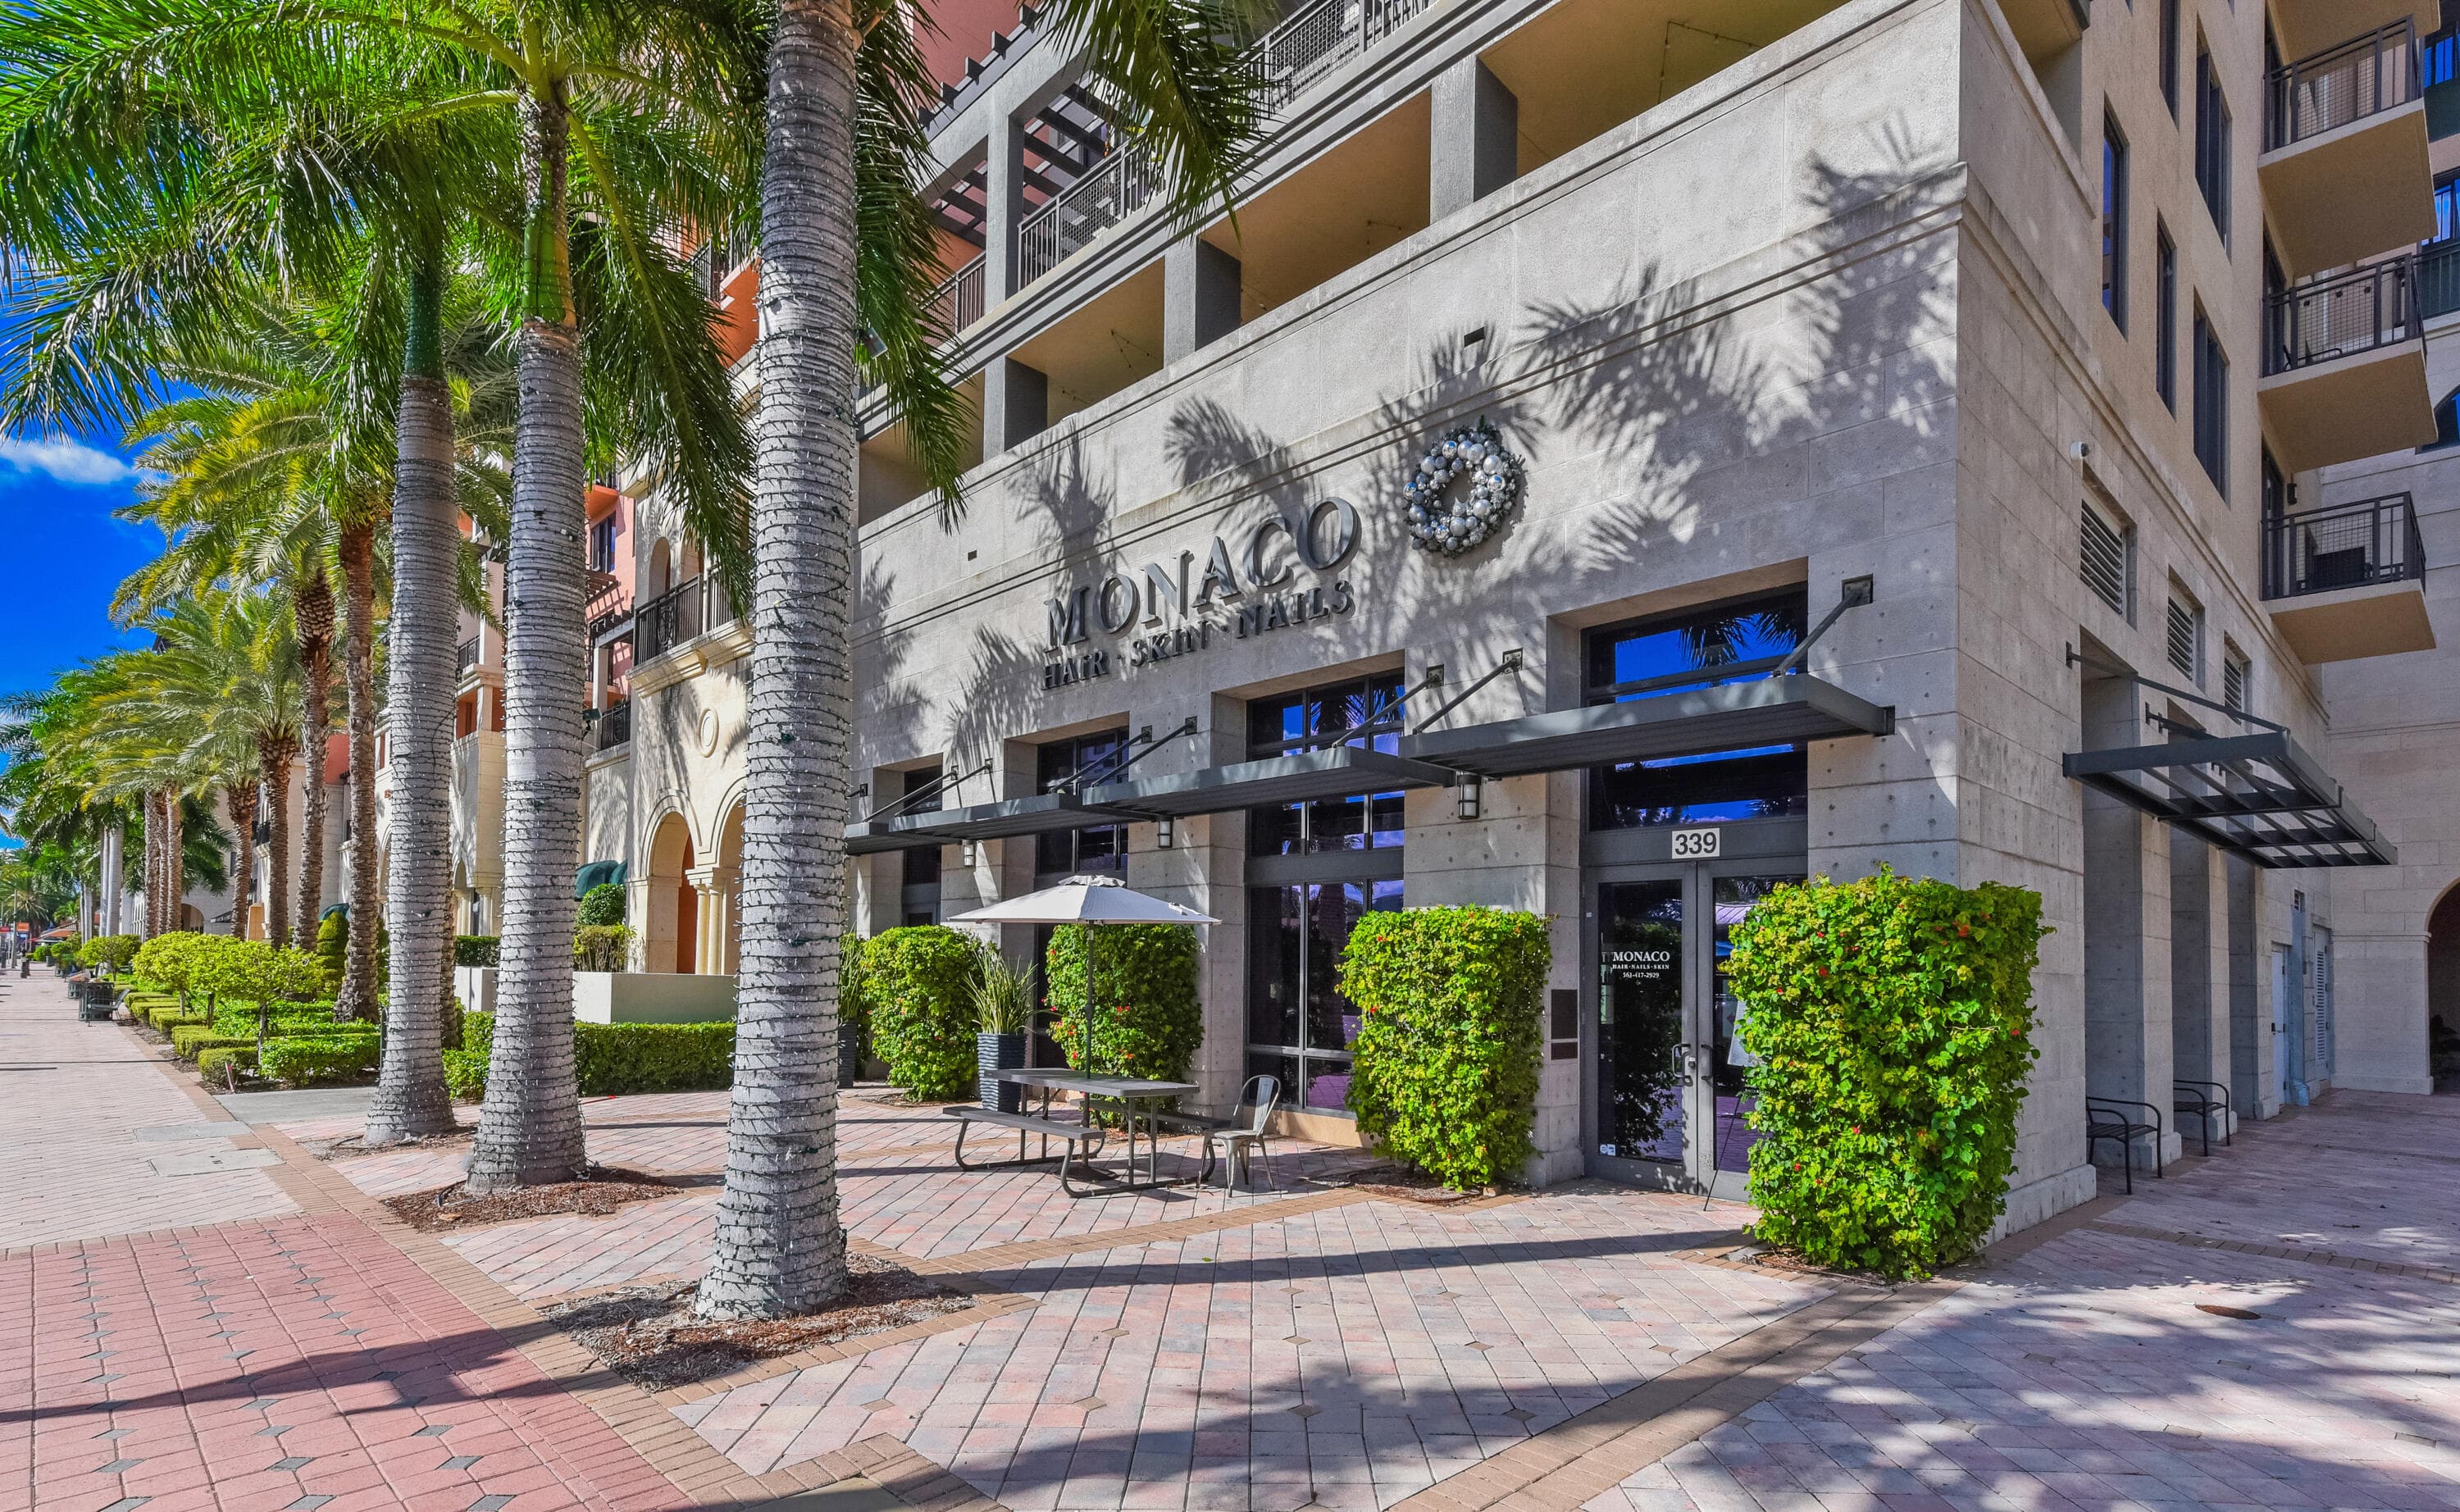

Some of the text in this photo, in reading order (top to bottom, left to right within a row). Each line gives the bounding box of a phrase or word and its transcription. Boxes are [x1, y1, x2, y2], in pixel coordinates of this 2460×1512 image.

[1043, 496, 1363, 654] MONACO
[1041, 580, 1355, 690] HAIR SKIN NAILS
[1674, 831, 1717, 855] 339
[1612, 951, 1670, 962] MONACO
